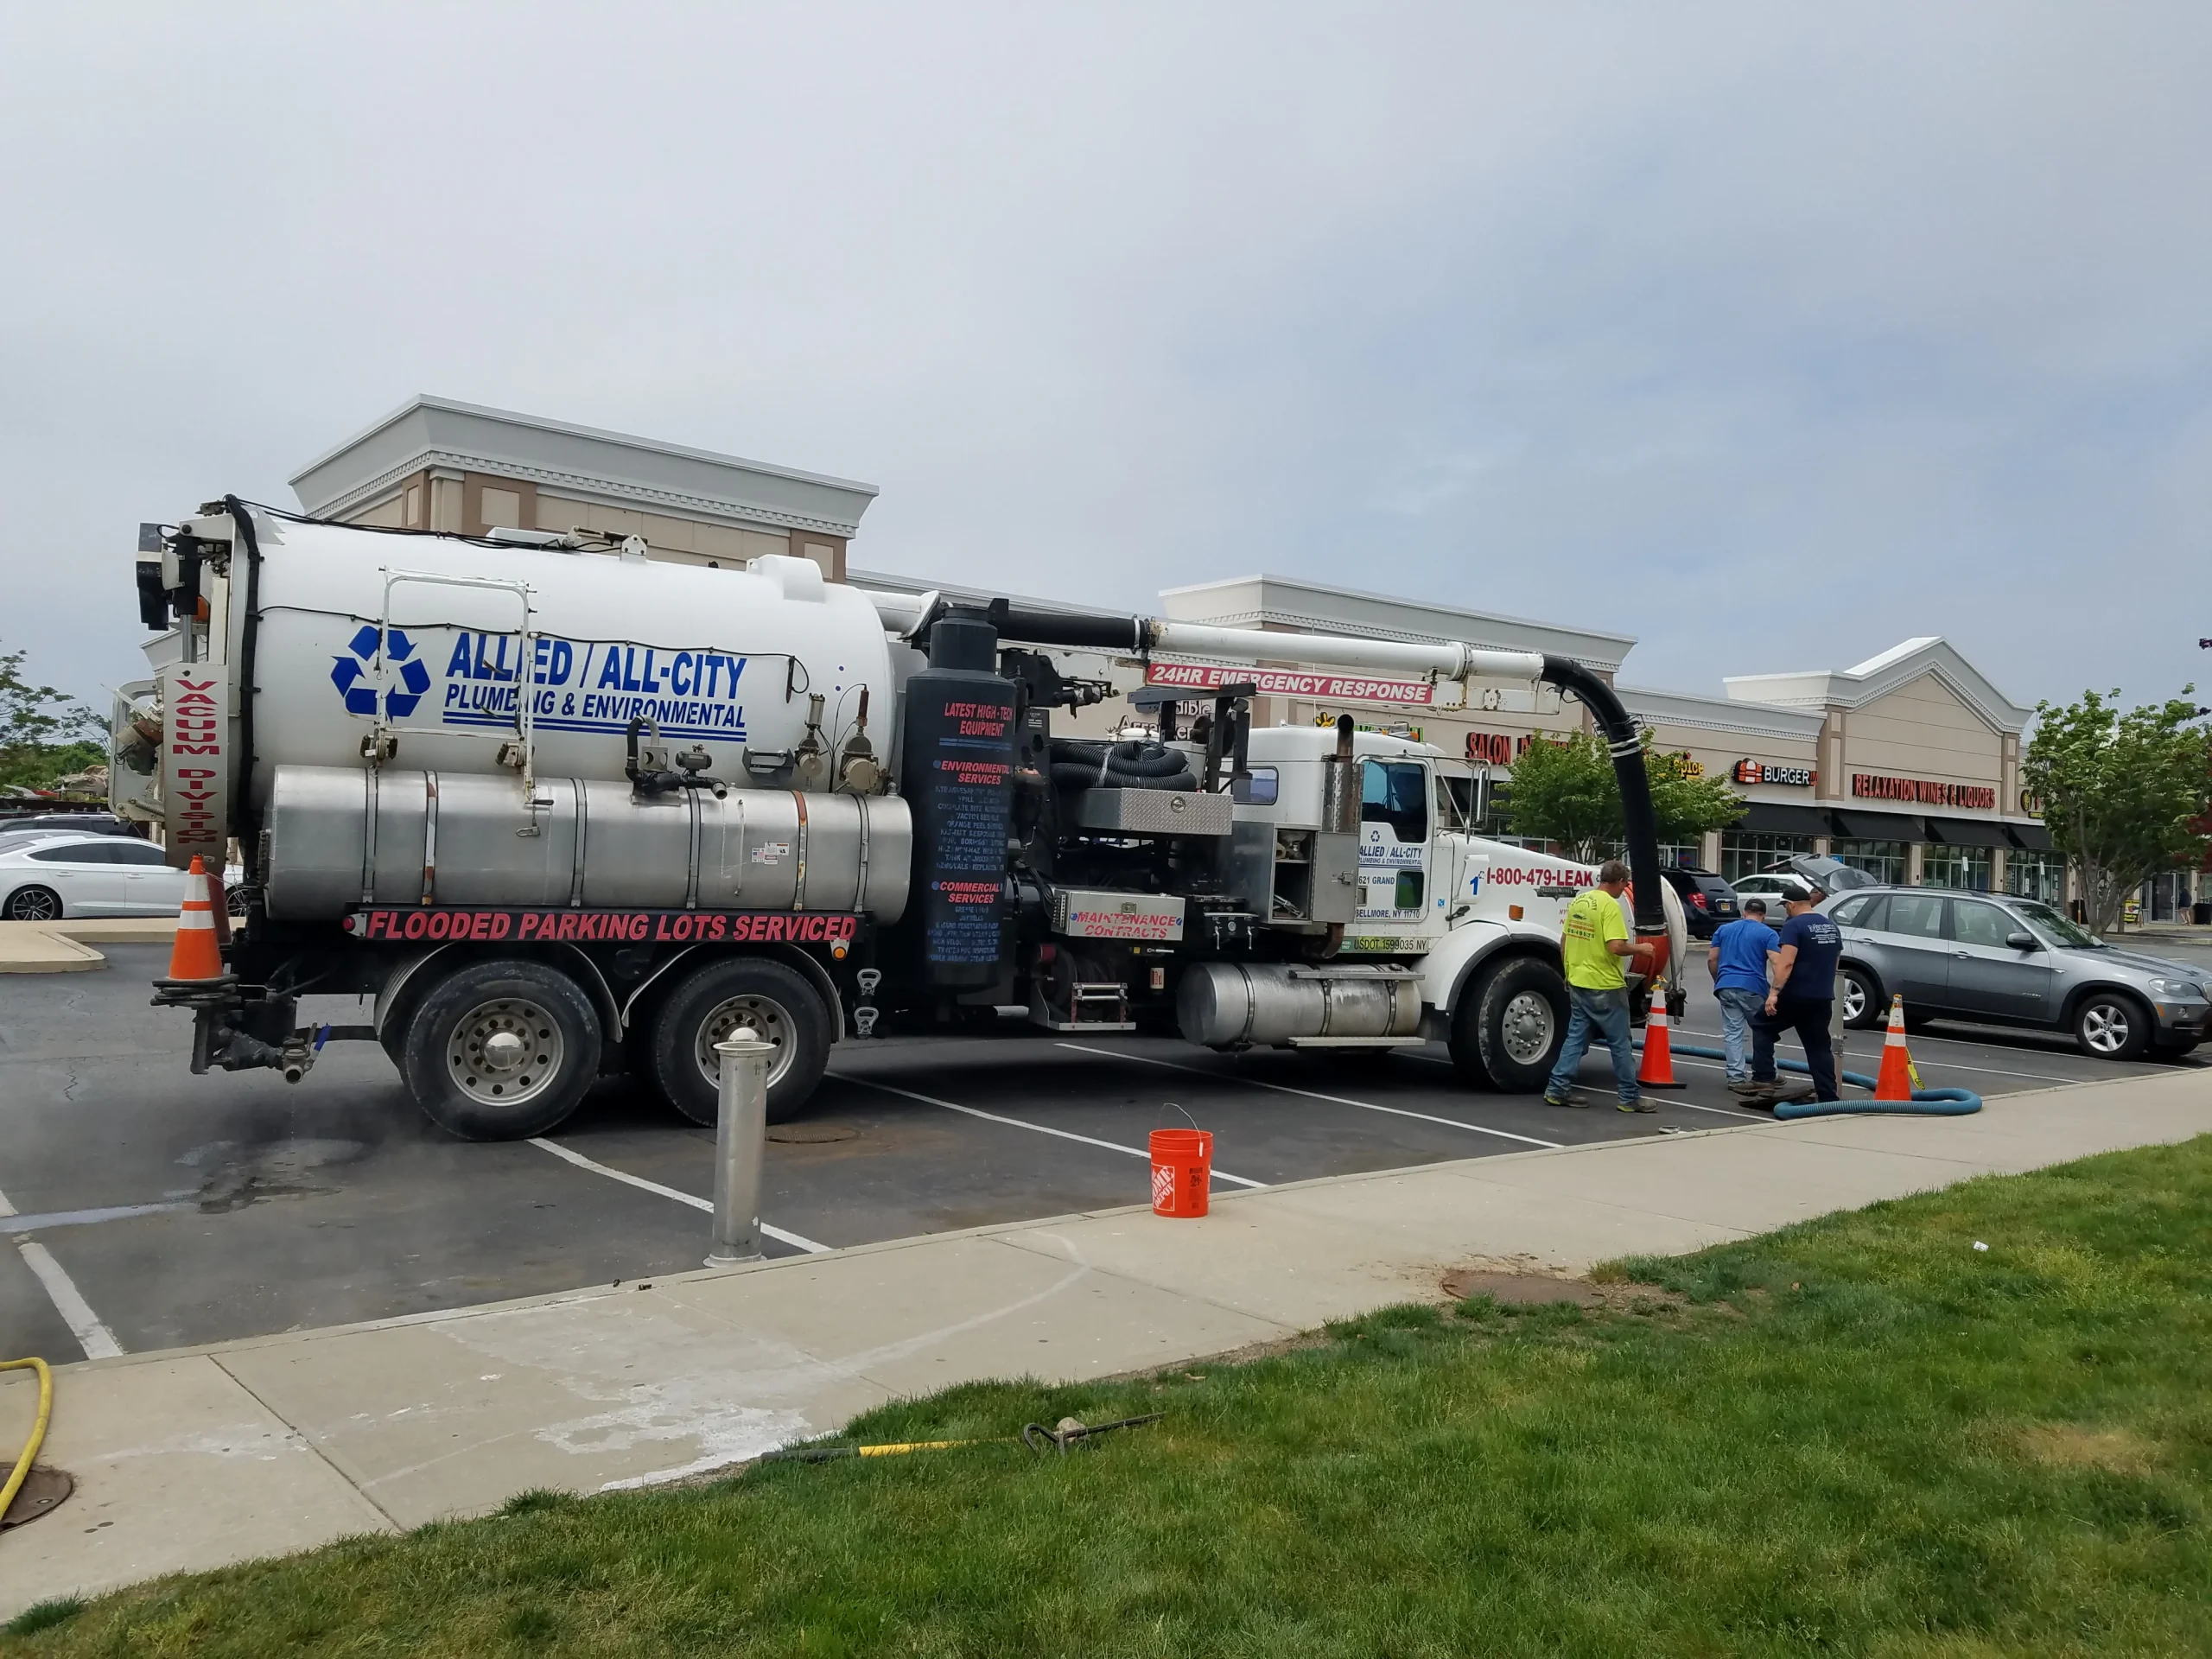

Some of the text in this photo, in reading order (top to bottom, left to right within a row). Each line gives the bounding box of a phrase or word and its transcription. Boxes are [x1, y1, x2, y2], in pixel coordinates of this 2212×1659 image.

[597, 645, 747, 700] ALL-CITY
[1151, 665, 1429, 702] 24HR EMERGENCY RESPONSE
[444, 683, 746, 728] PLUMBNG & ENVIRONMENTAL
[944, 702, 976, 718] LATEST
[172, 679, 220, 755] VACUUM
[959, 720, 1004, 736] EQUIPMENT
[1468, 731, 1511, 766] SALON
[941, 760, 1010, 774] ENVIRONMENTAL
[957, 772, 1001, 785] SERVICES
[1855, 773, 1996, 809] RELAXATION WINES & LIQUORS
[175, 768, 219, 844] DIVISION
[1359, 845, 1385, 857] ALLIED
[1390, 847, 1423, 858] ALL-CITY
[1372, 876, 1395, 885] GRAND
[1486, 867, 1594, 887] 1-800-479-LEAK
[939, 881, 1000, 893] COMMERCIAL
[1470, 876, 1479, 896] 1
[948, 893, 995, 904] SERVICES
[1077, 912, 1176, 927] MAINTENANCE
[1392, 910, 1402, 918] NY
[1403, 910, 1421, 918] 11710
[366, 911, 857, 941] FLOODED PARKING LOTS SERVICED
[1084, 925, 1167, 938] CONTRACTS
[1353, 938, 1427, 950] USDOT 1599035 NY
